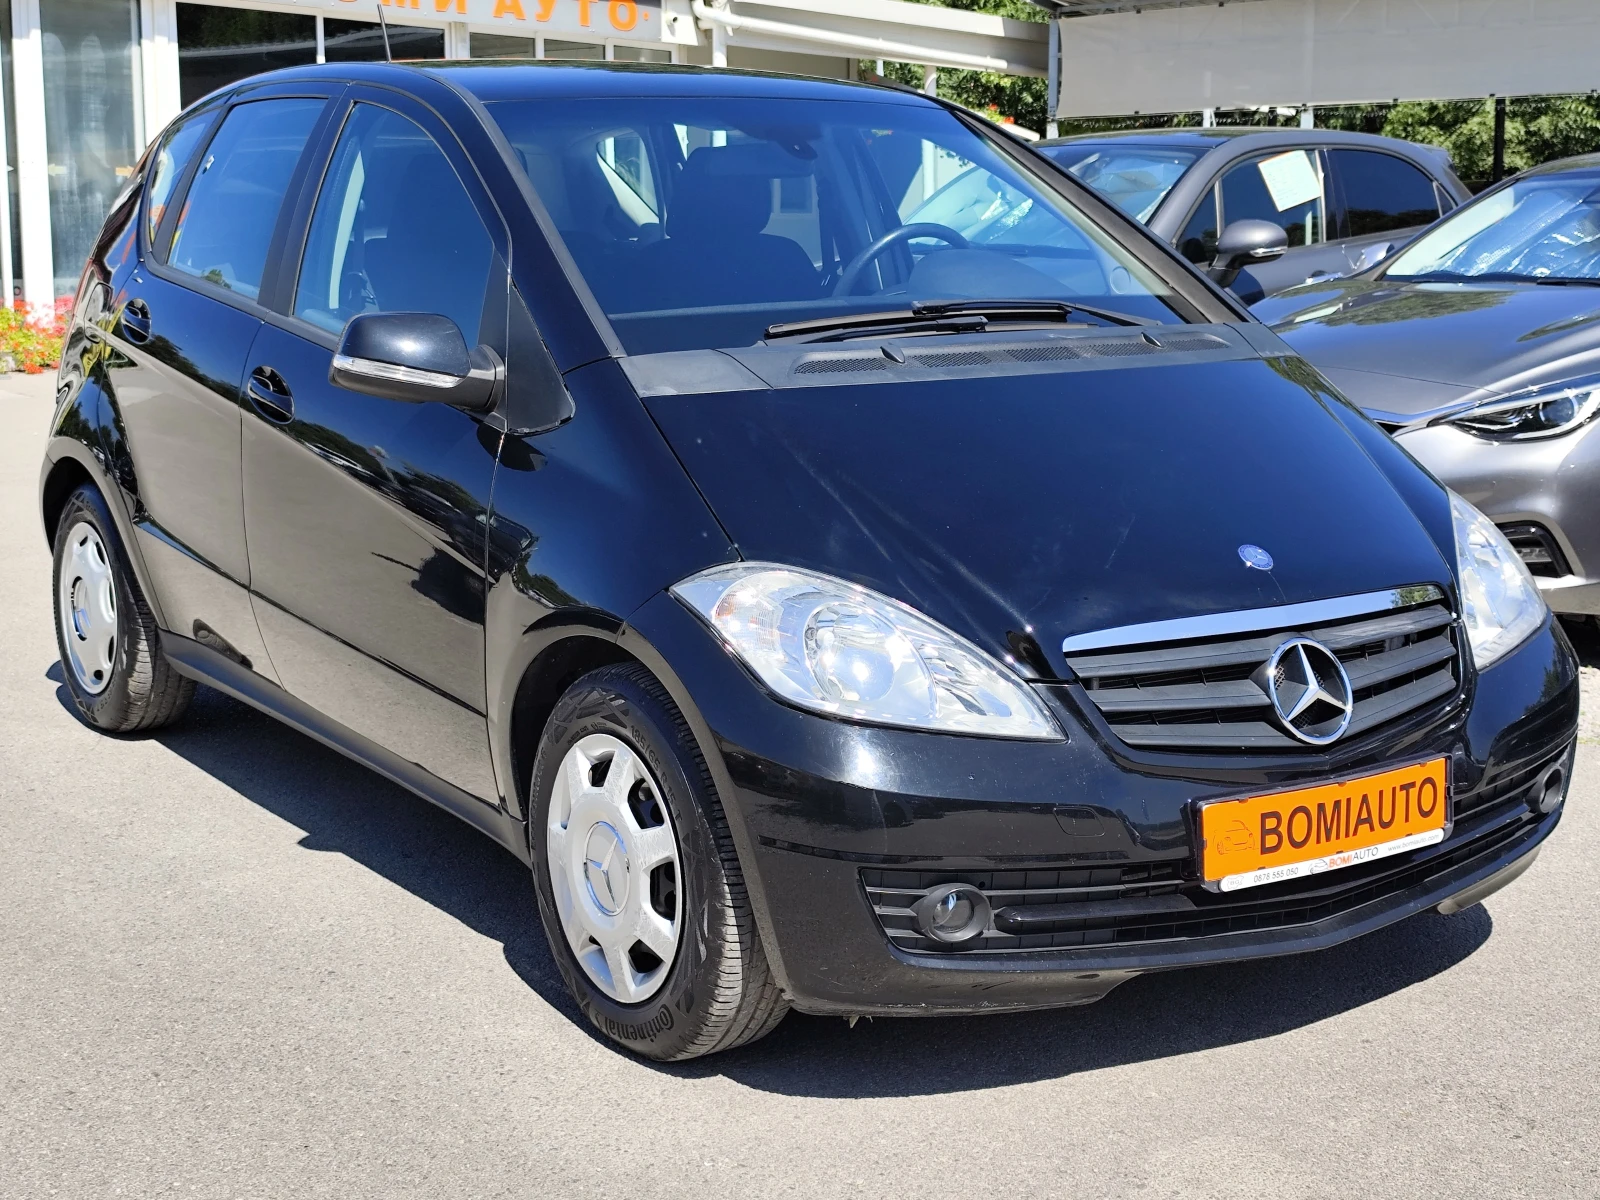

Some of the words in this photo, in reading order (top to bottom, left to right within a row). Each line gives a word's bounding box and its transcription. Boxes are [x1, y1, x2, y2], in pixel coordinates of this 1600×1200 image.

[1260, 776, 1438, 855] BOMIAUTO
[1387, 833, 1440, 852] www.bomiauto.com
[1253, 872, 1270, 883] 0878
[1271, 869, 1285, 880] 555
[1285, 867, 1299, 877] 050
[604, 1003, 675, 1043] Continental
